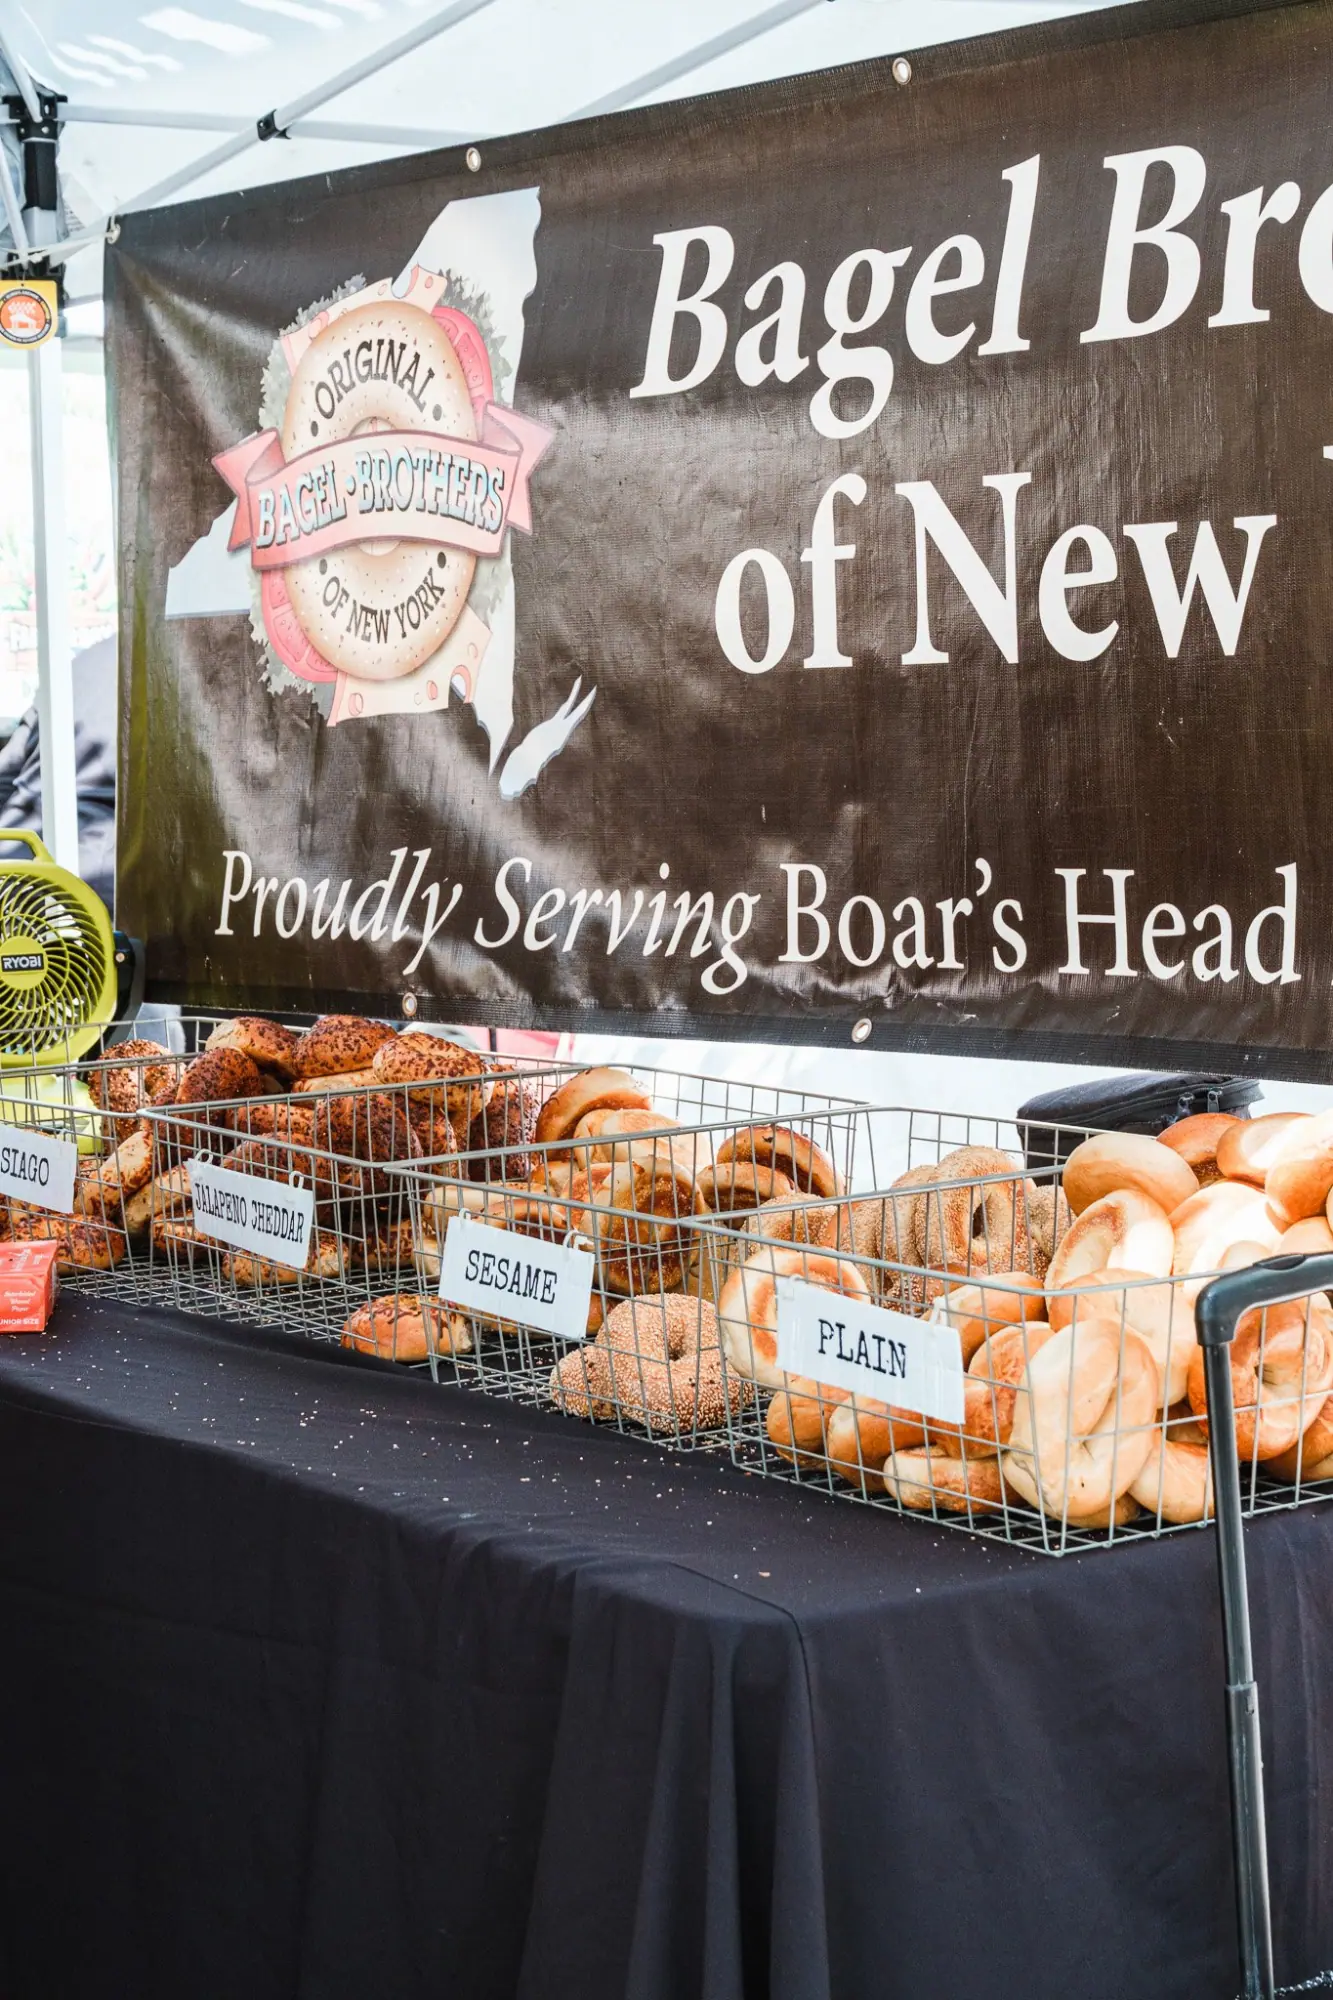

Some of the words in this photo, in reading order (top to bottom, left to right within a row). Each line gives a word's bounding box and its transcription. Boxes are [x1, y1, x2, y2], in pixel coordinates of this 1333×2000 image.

[630, 154, 1041, 439] Bagel
[315, 339, 435, 419] ORIGINAL
[256, 460, 347, 549] BAGEL
[355, 446, 505, 534] BROTHERS
[322, 576, 350, 618] OF
[345, 599, 391, 644] NEW
[394, 567, 445, 638] YORK
[715, 473, 867, 674] of
[895, 472, 1277, 664] New
[215, 846, 463, 975] Proudly
[474, 856, 761, 995] Serving
[778, 858, 1027, 973] Boar's
[1055, 862, 1302, 985] Head
[3, 956, 41, 969] RYOBI
[194, 1182, 247, 1227] JALAPENO
[251, 1199, 305, 1243] CHEDDAR
[465, 1250, 558, 1304] SESAME
[816, 1318, 907, 1379] PLAIN
